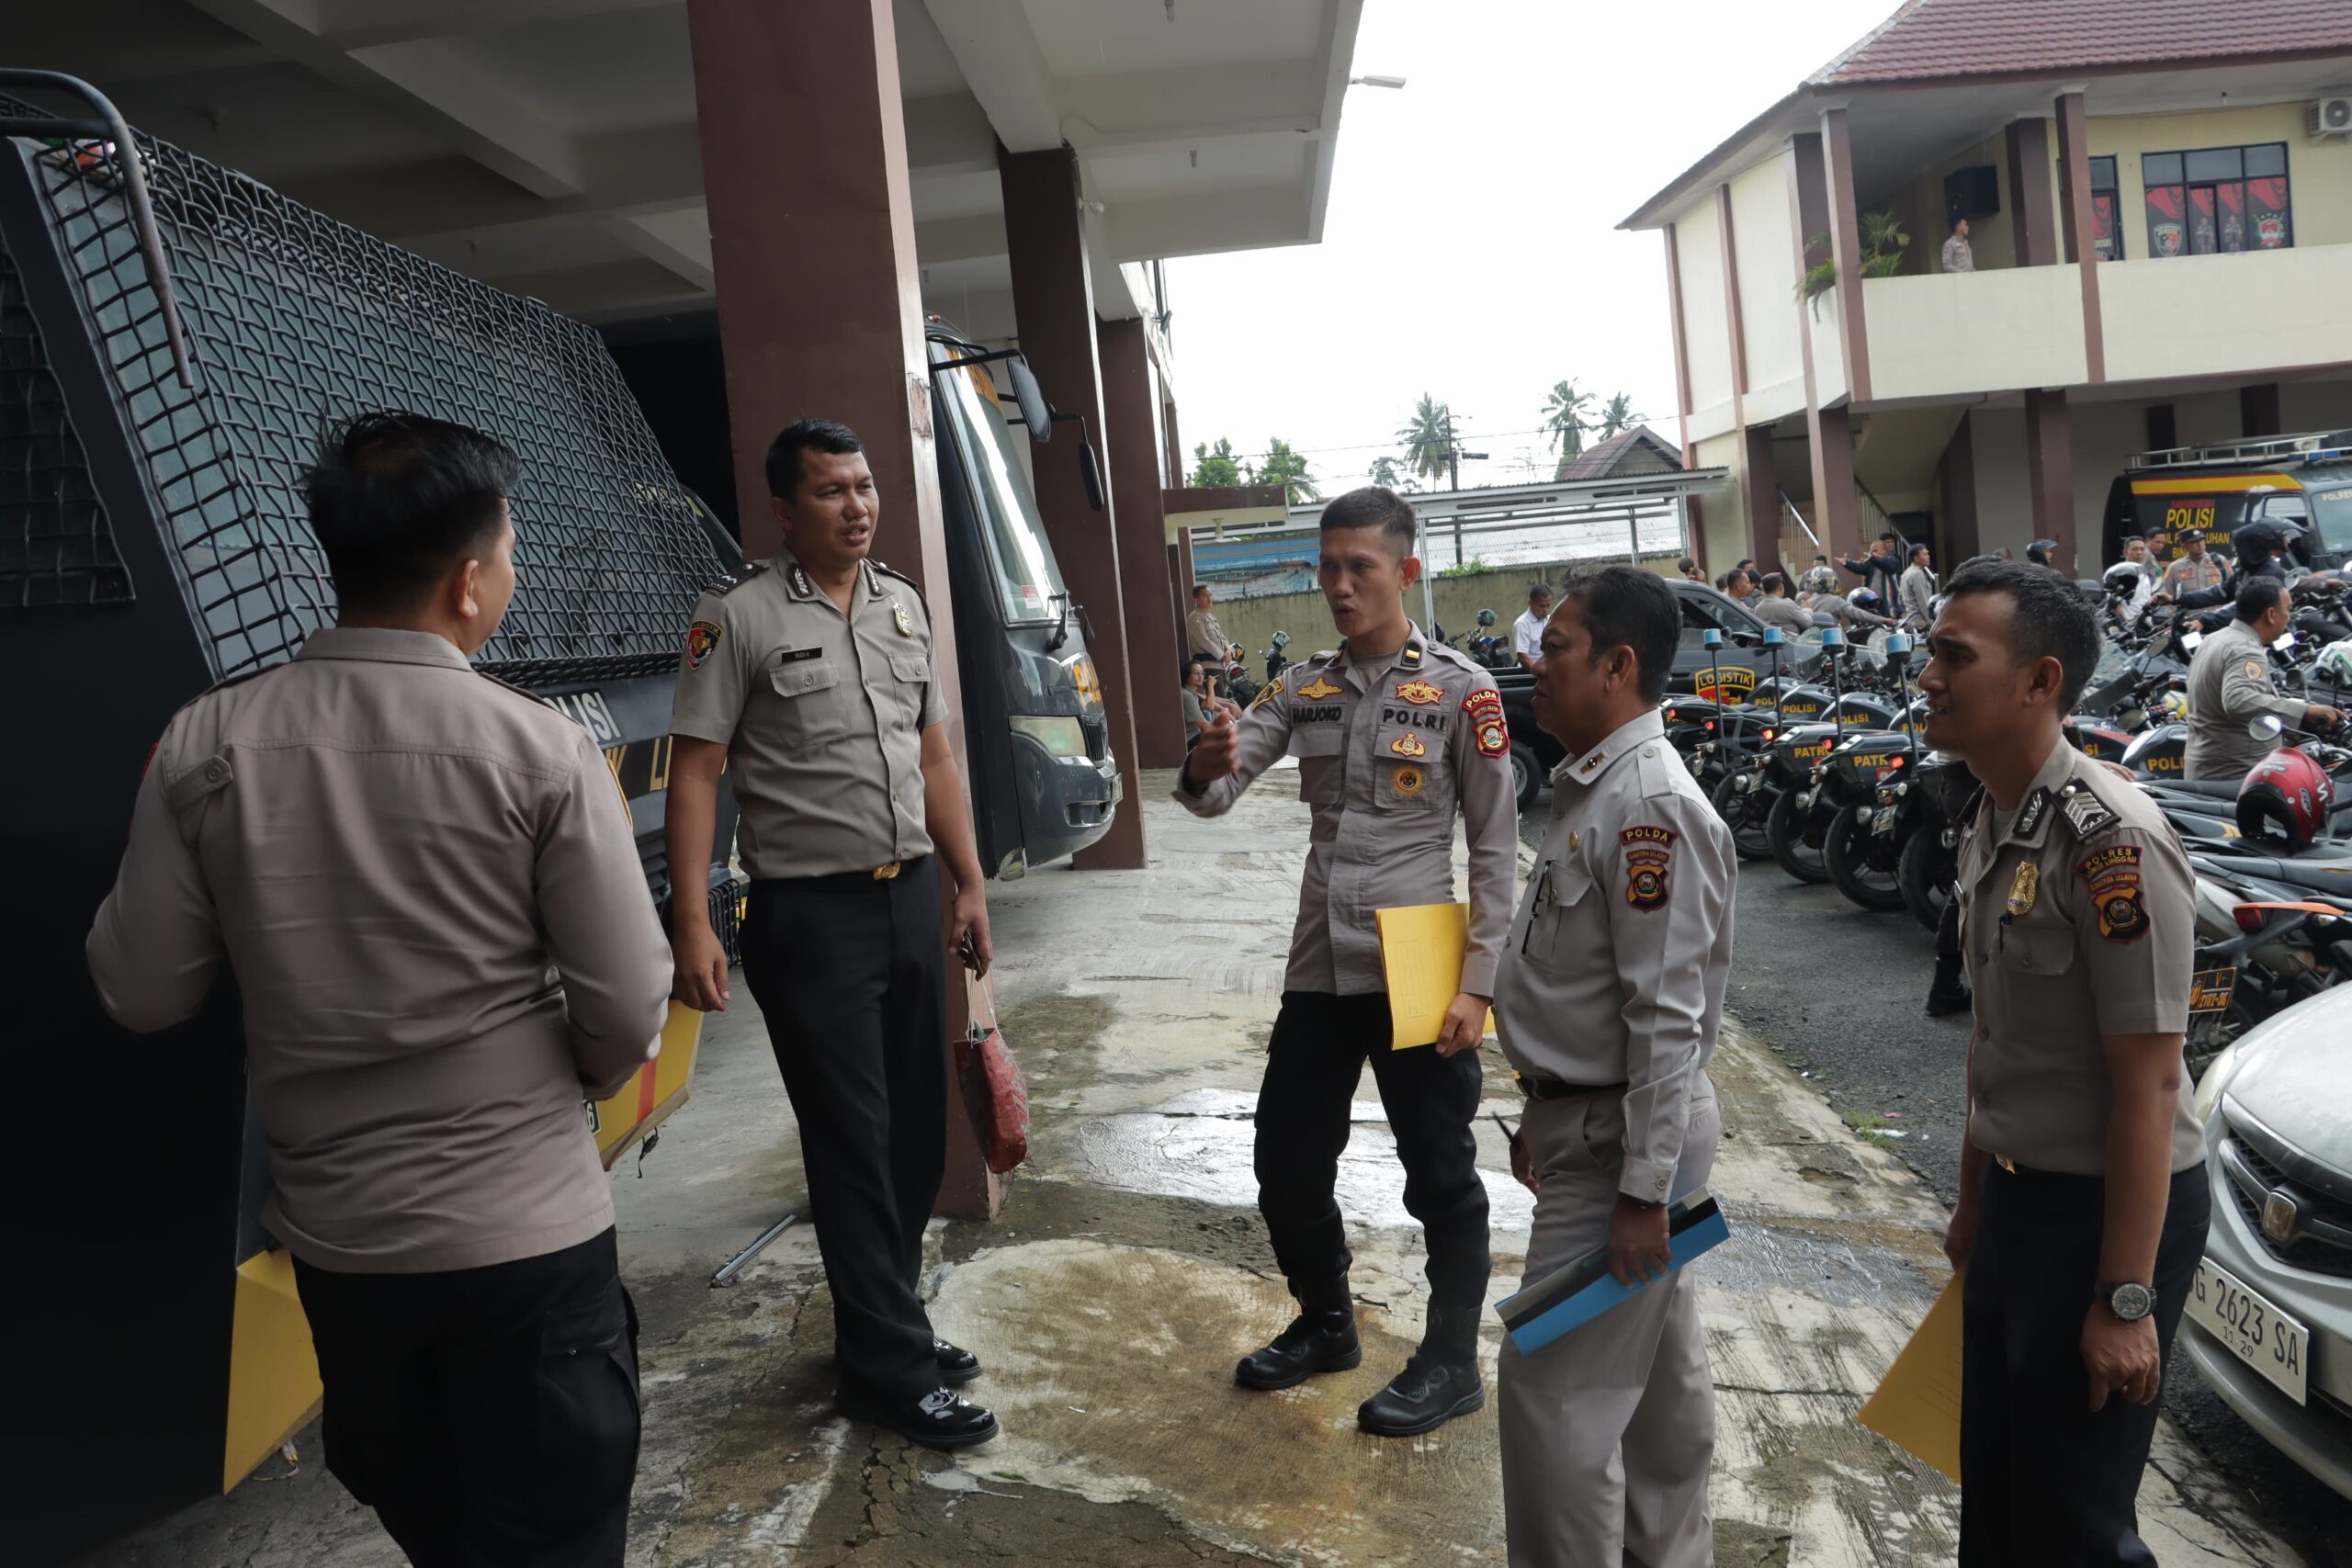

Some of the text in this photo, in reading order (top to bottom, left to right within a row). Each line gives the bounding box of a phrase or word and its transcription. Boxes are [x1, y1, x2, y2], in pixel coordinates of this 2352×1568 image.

[2165, 507, 2215, 529] POLISI
[1465, 691, 1497, 707] POLDA
[1783, 704, 1816, 714] POLISI
[1383, 708, 1446, 730] POLRI
[1626, 829, 1668, 842] POLDA
[2086, 847, 2132, 870] POLRES
[2215, 1278, 2264, 1346] 2623
[2274, 1321, 2299, 1376] SA
[2240, 1340, 2254, 1358] 29
